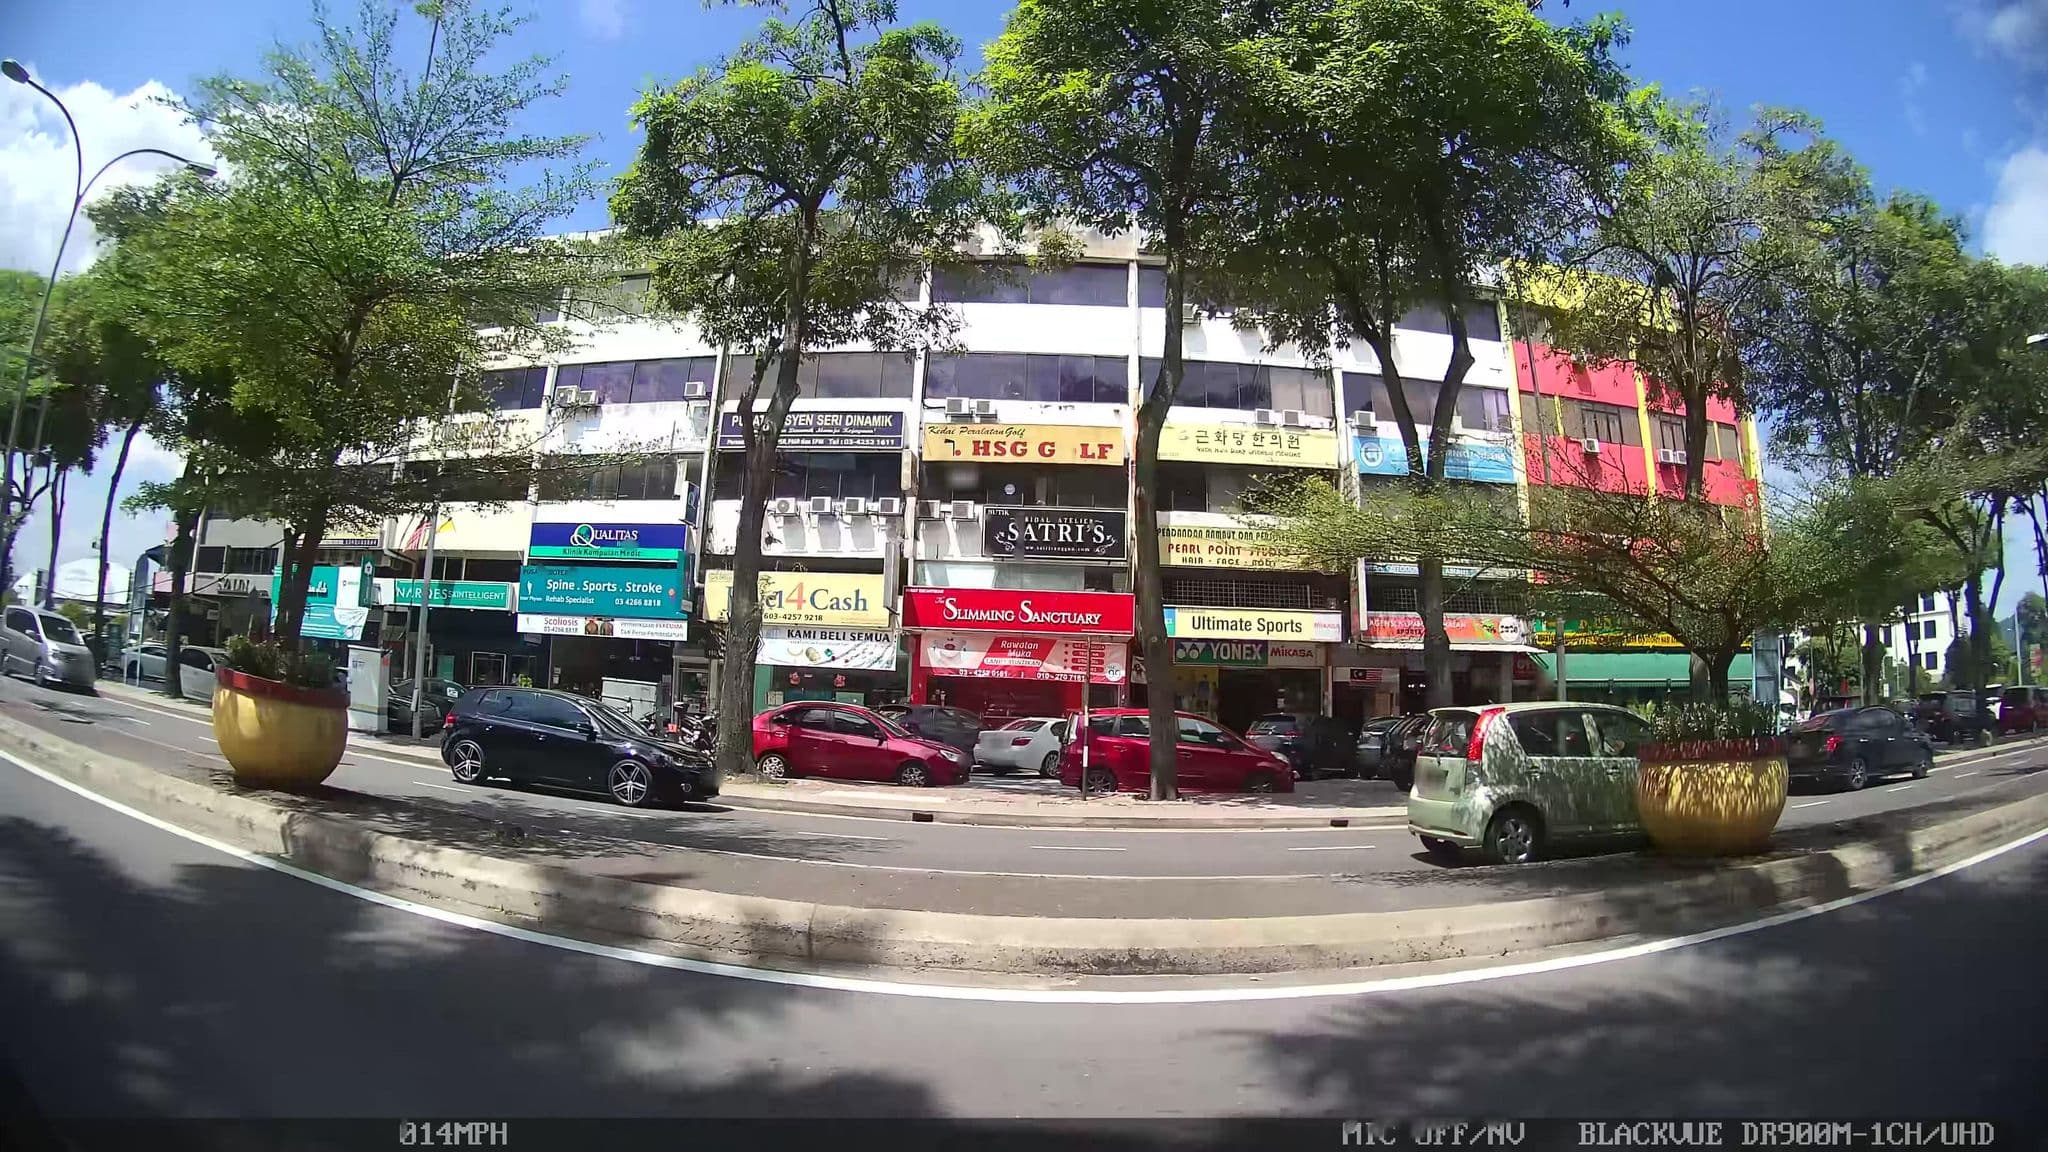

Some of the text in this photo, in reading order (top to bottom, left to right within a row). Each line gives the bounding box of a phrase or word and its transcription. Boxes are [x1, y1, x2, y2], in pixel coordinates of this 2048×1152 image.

[731, 415, 764, 427] PUAT
[817, 414, 842, 426] SERI
[845, 415, 893, 427] DINAMIK
[928, 425, 1026, 438] Kedai Peralatan Golf
[971, 439, 1114, 460] HSG GLF
[570, 523, 639, 549] QUALITAS
[1007, 522, 1106, 544] SATRI'S
[1167, 543, 1201, 555] PEARL
[1208, 543, 1243, 556] POINT
[1182, 556, 1204, 564] HAIR
[1216, 557, 1240, 566] FACE
[546, 579, 663, 594] Spine Sports Stroke
[545, 595, 595, 604] Rehab Specialist
[943, 597, 1015, 622] SLIMMING
[1018, 600, 1102, 625] SANCTUARY
[543, 616, 579, 627] Scoliosis
[1192, 615, 1303, 635] Ultimate Sports
[787, 629, 816, 640] KAMI
[820, 630, 846, 641] BELI
[850, 632, 890, 643] SEMUA
[1007, 649, 1032, 658] Muka
[1210, 642, 1262, 660] YONEX
[1270, 645, 1314, 658] MiKASA
